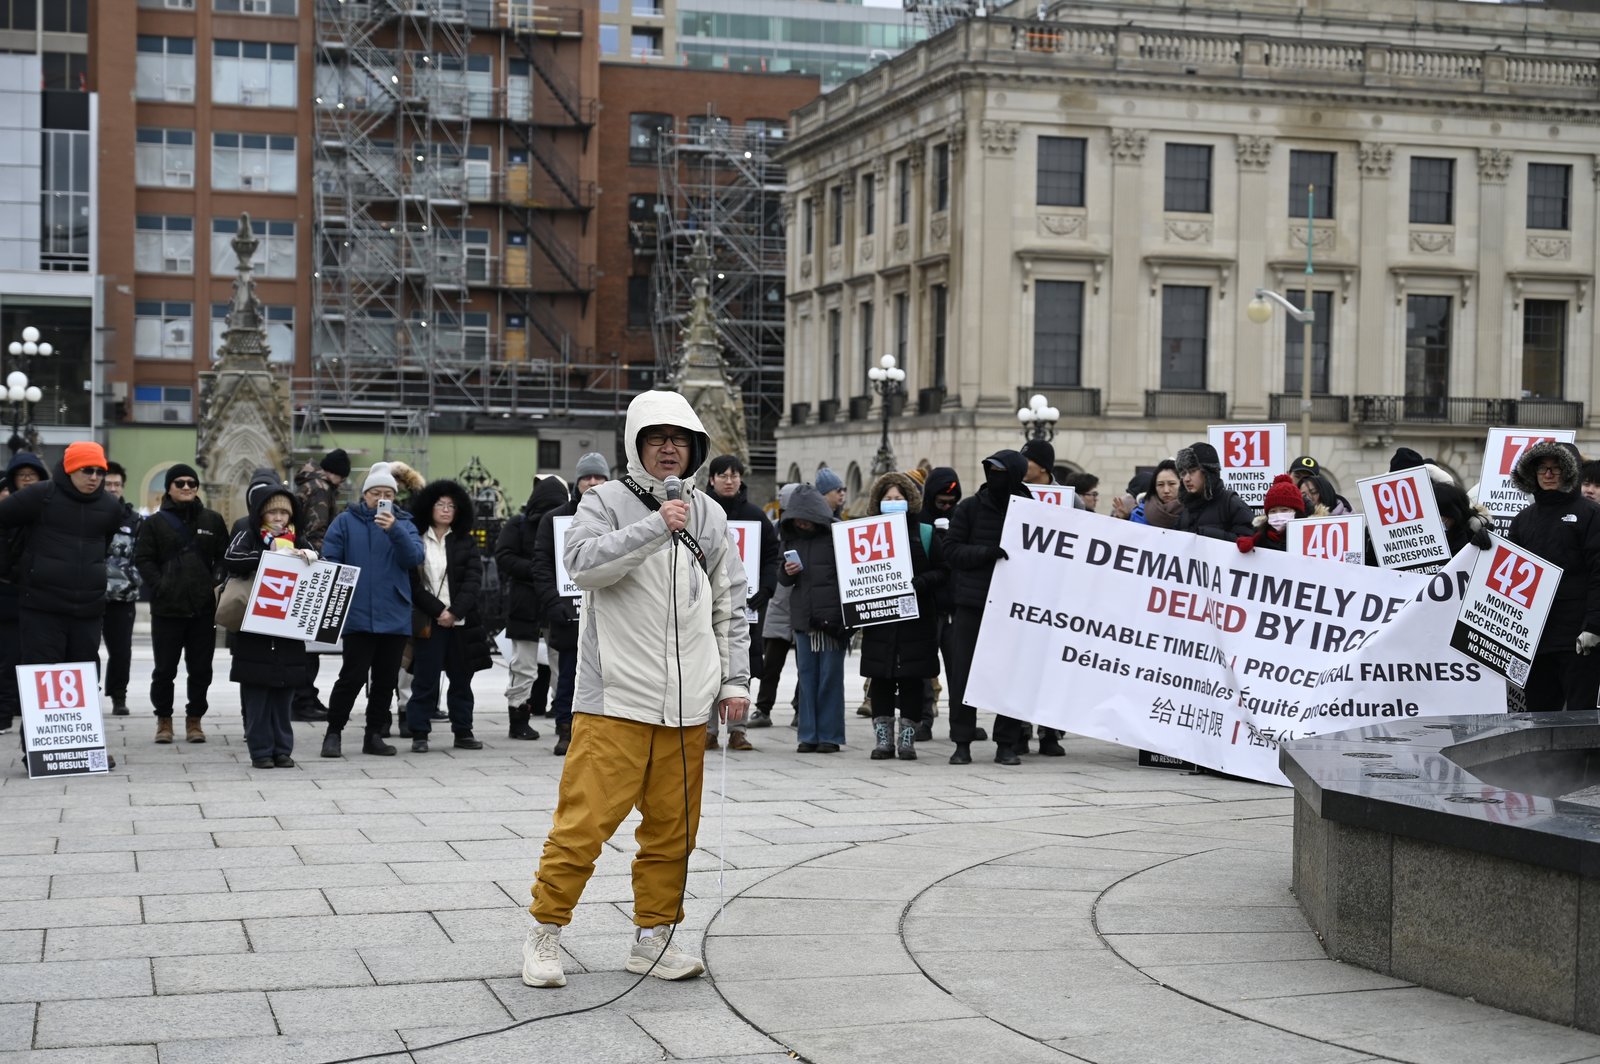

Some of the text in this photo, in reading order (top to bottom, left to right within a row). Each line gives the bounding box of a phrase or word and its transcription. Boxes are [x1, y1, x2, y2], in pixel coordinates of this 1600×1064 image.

[1229, 431, 1265, 467] 31
[624, 478, 646, 496] SONY
[1224, 482, 1256, 491] AITING
[1228, 472, 1265, 481] MONTHS
[1378, 479, 1417, 524] 90
[853, 522, 891, 563] 54
[1307, 523, 1344, 561] 40
[1383, 534, 1436, 553] WAITING FOR
[1388, 524, 1424, 539] MONTHS
[856, 561, 892, 576] MONTHS
[1382, 545, 1444, 566] IRCC RESPONSE
[848, 571, 903, 588] WAITING FOR
[1021, 522, 1079, 560] WE
[1085, 537, 1210, 589] DEMAND
[1211, 565, 1222, 594] A
[1229, 568, 1357, 618] TIMELY
[1493, 552, 1536, 605] 42
[256, 574, 295, 613] 14
[290, 579, 308, 618] MONTHS
[297, 571, 322, 629] WAITING FOR
[305, 568, 333, 636] IRCC RESPONSE
[845, 580, 909, 599] IRCC RESPONSE
[330, 585, 349, 628] NO RESULTS
[855, 603, 866, 613] NO
[859, 611, 870, 621] NO
[1146, 586, 1248, 634] DELAYED
[1254, 611, 1305, 646] BY
[1473, 600, 1530, 639] WAITING FOR
[1485, 593, 1524, 621] MONTHS
[321, 618, 331, 630] NO
[1464, 609, 1531, 654] IRCC RESPONSE
[1467, 630, 1479, 643] NO
[1009, 602, 1160, 651] REASONABLE
[1360, 662, 1482, 683] FAIRNESS
[1467, 641, 1510, 672] NO RESULTS
[41, 670, 79, 709] 18
[1061, 645, 1420, 723] Délais raisonnables Équité procédurale
[36, 722, 93, 735] WAITING FOR
[44, 712, 83, 723] MONTHS
[1149, 696, 1225, 738] 给出时限
[32, 733, 99, 747] IRCC RESPONSE
[42, 753, 54, 762] NO
[46, 760, 89, 771] NO RESULTS
[1151, 754, 1159, 763] NO
